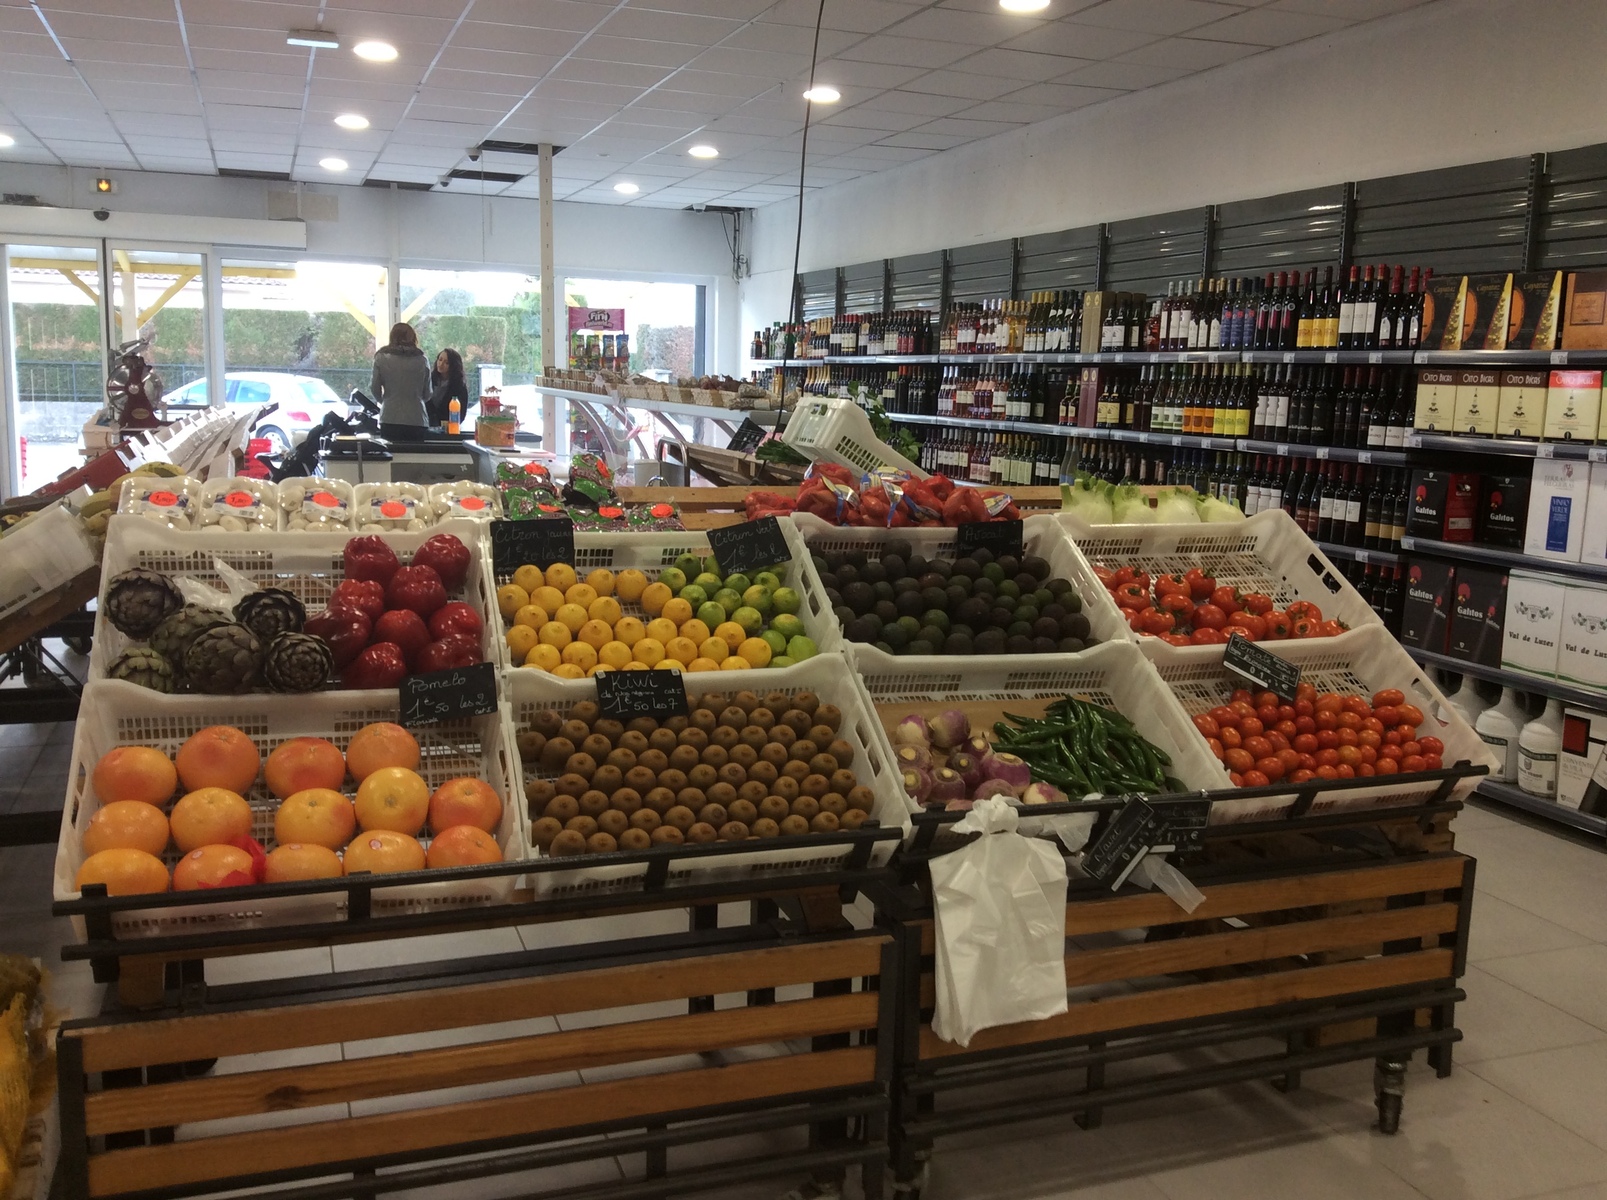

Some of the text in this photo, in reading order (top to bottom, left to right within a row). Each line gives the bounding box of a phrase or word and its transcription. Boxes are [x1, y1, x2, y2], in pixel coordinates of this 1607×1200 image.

[496, 527, 540, 543] Citron
[715, 531, 754, 547] Citron
[1508, 631, 1520, 640] Val
[1565, 643, 1577, 652] Val
[1581, 647, 1590, 655] de
[407, 672, 466, 694] Pomelo
[668, 698, 679, 710] 7
